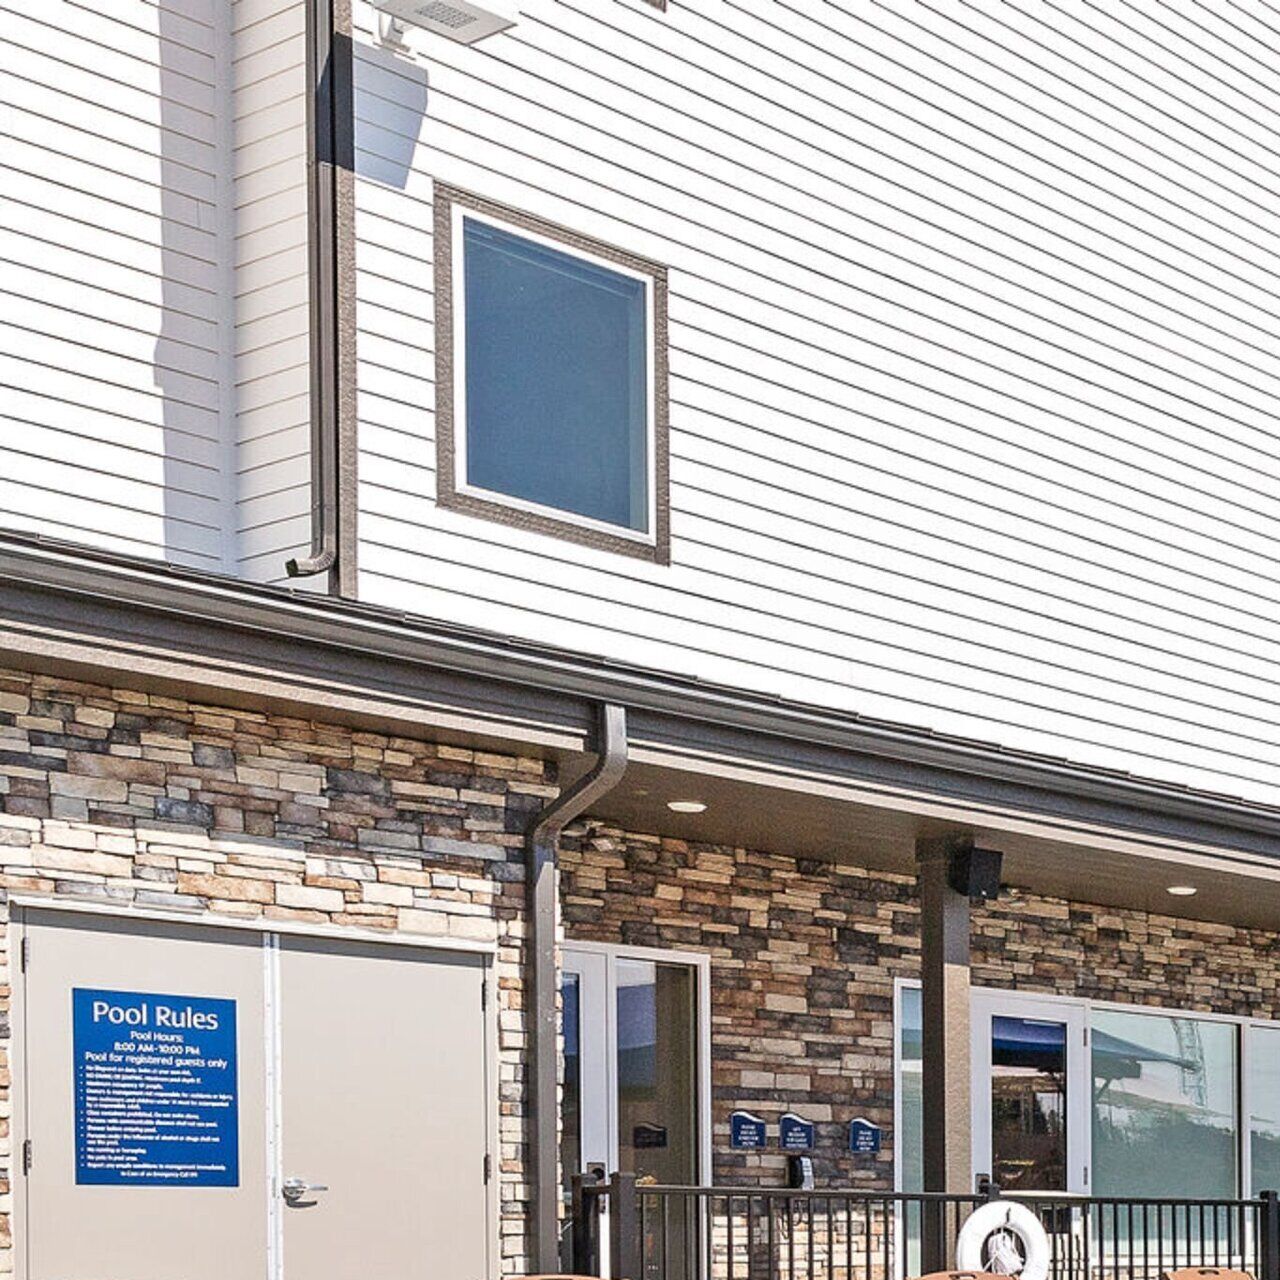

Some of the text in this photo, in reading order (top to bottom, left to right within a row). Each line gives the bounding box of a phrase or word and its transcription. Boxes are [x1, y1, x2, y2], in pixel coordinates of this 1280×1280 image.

[93, 1001, 218, 1030] Pool Rules
[130, 1030, 151, 1041] Pool
[114, 1042, 136, 1052] 8:00
[185, 1046, 200, 1055] PM
[85, 1051, 228, 1069] Pool for registered guests only
